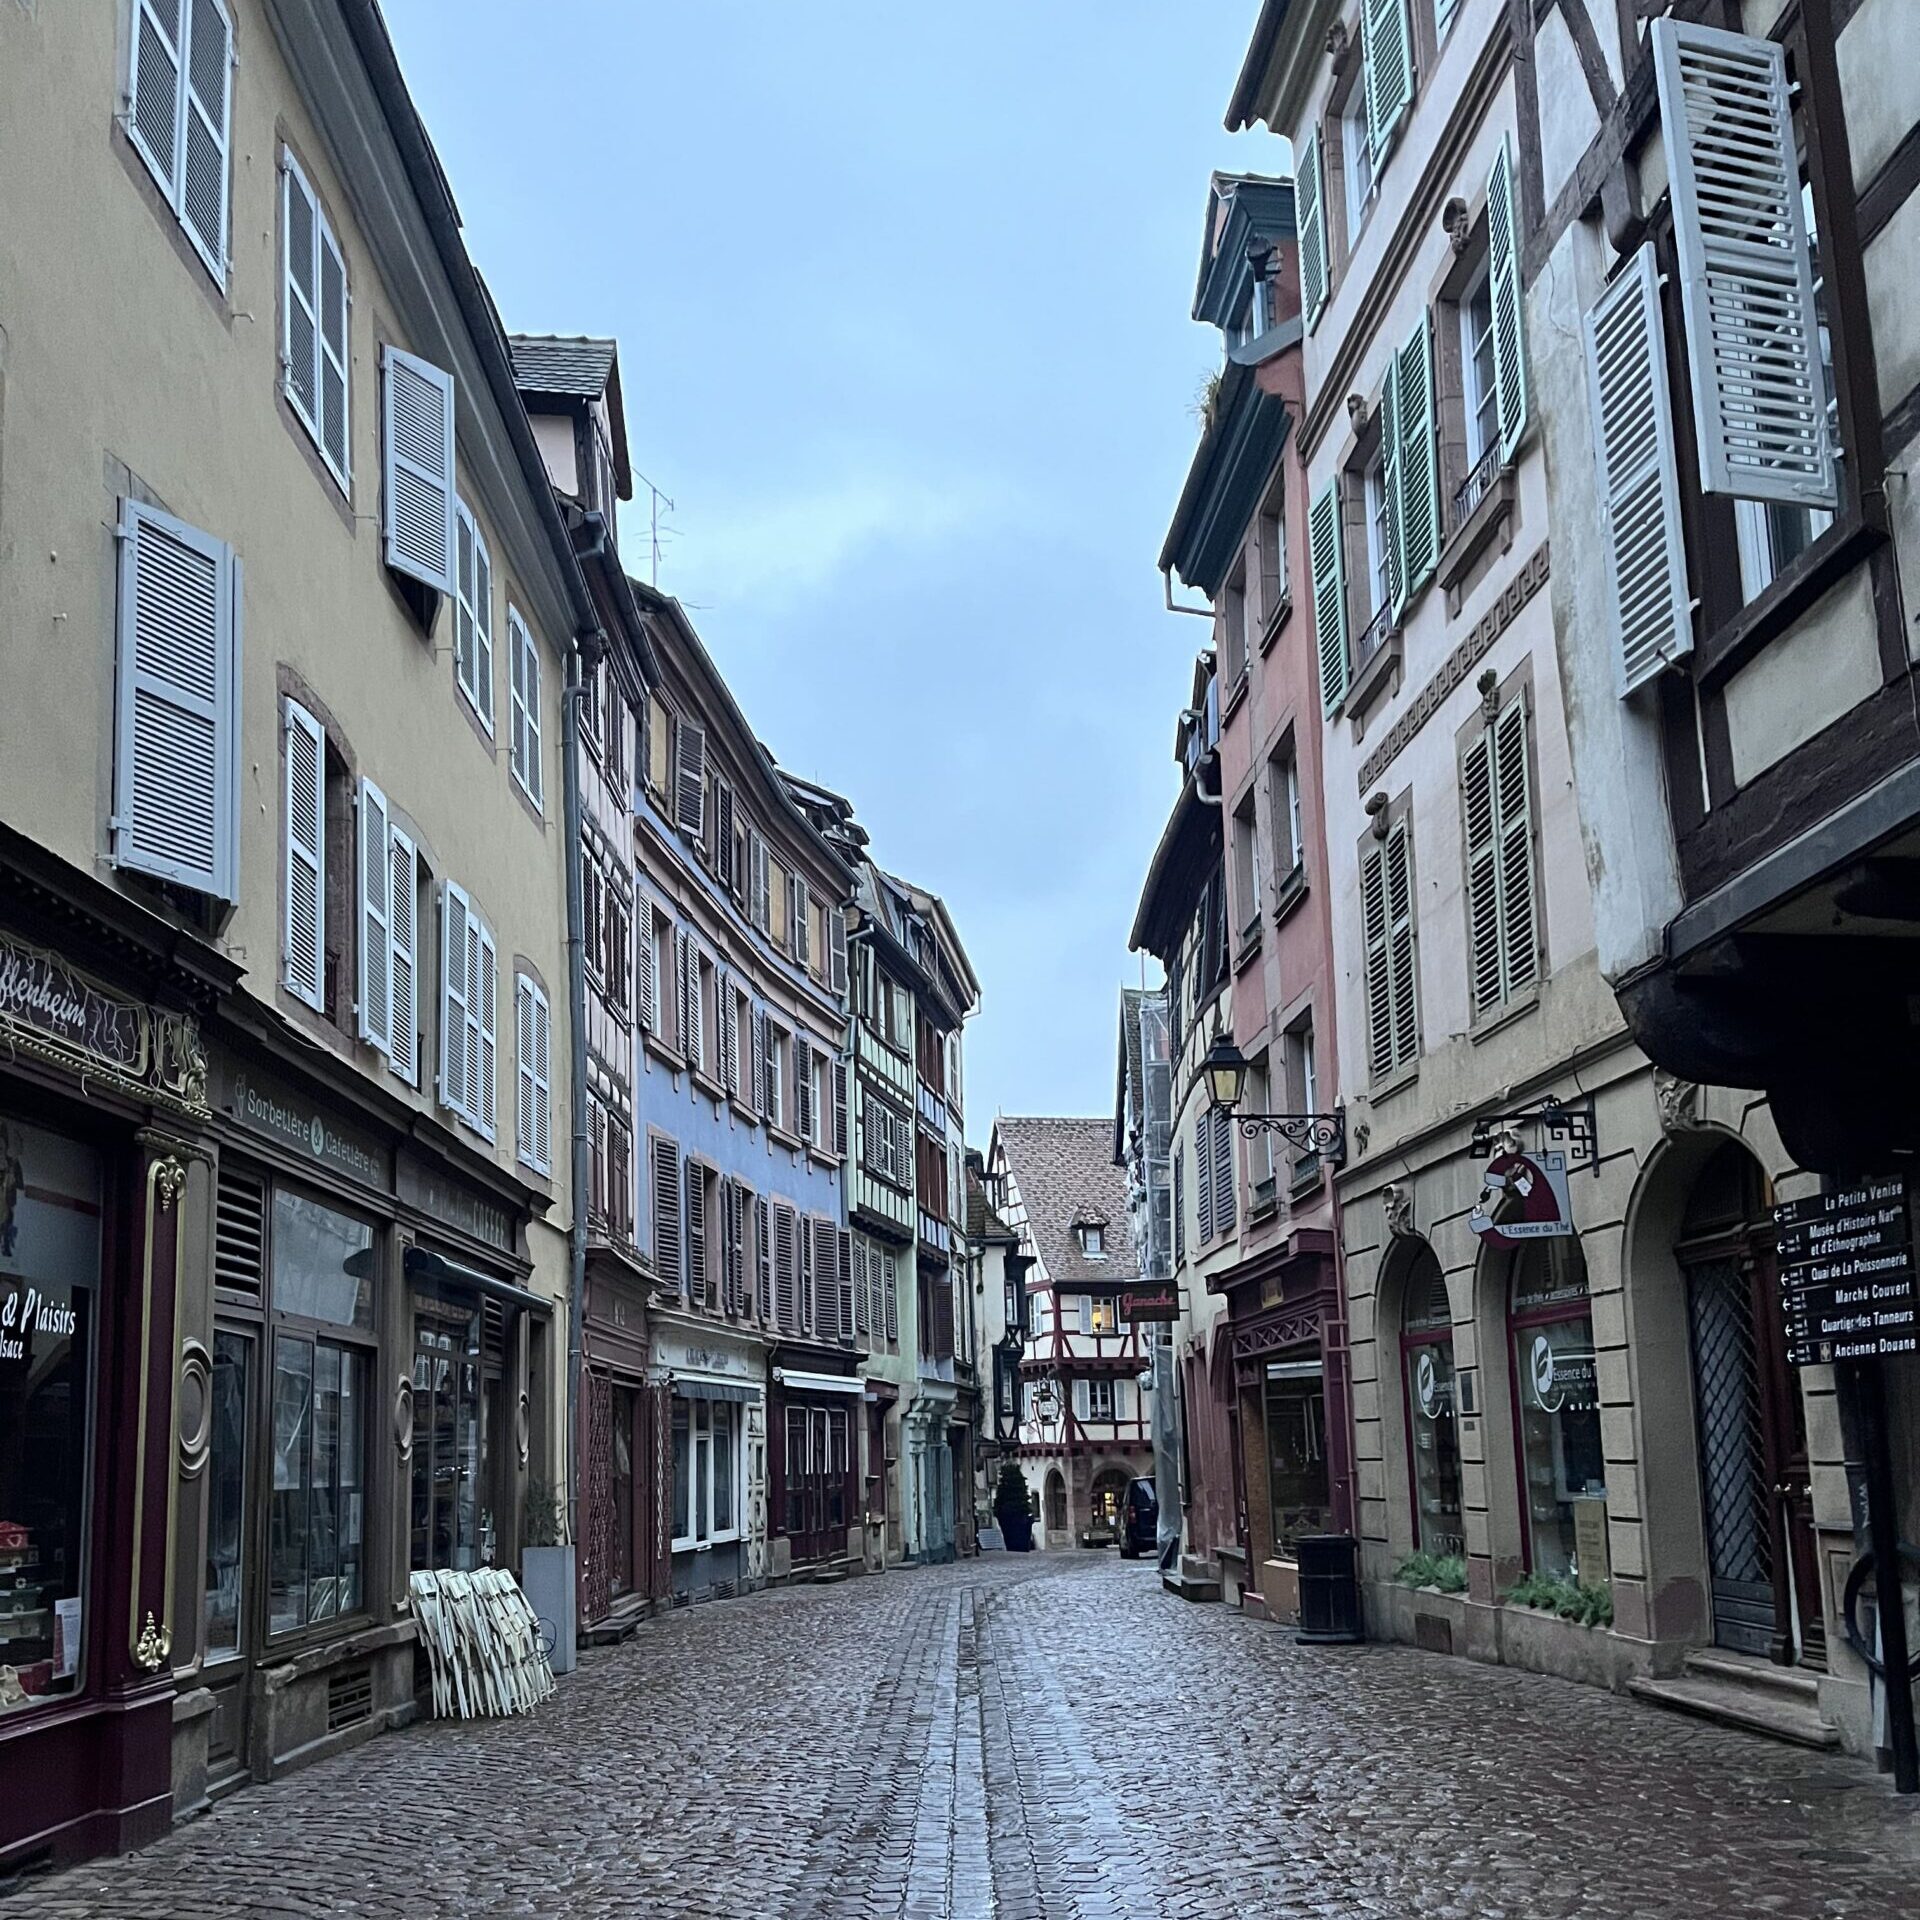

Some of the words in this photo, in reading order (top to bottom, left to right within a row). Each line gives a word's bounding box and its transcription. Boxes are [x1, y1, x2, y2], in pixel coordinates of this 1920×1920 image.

[247, 1089, 310, 1142] Sorbetière
[325, 1130, 369, 1172] Cafetière
[1825, 1197, 1836, 1211] La
[1838, 1190, 1867, 1208] Petite
[1869, 1182, 1903, 1200] Venise
[1502, 1225, 1540, 1235] L'Essence
[1542, 1223, 1553, 1233] du
[1555, 1222, 1570, 1232] Thé
[1809, 1221, 1835, 1239] Musée
[1836, 1213, 1876, 1233] d'Histoire
[1810, 1242, 1819, 1256] et
[1821, 1229, 1881, 1254] d'Ethnographie
[1811, 1265, 1829, 1280] Quai
[1830, 1264, 1841, 1278] de
[1842, 1261, 1852, 1276] La
[1854, 1252, 1907, 1274] Poissonnerie
[1122, 1288, 1176, 1316] Ganache
[1835, 1285, 1869, 1304] Marché
[1872, 1281, 1910, 1299] Couvert
[2, 1292, 18, 1327] &
[20, 1287, 77, 1335] Plaisirs
[1821, 1316, 1855, 1333] Quartier
[1873, 1310, 1914, 1326] Tanneurs
[1834, 1342, 1877, 1358] Ancienne
[1879, 1338, 1916, 1353] Douane
[1553, 1366, 1581, 1381] Essence
[1581, 1363, 1592, 1379] du
